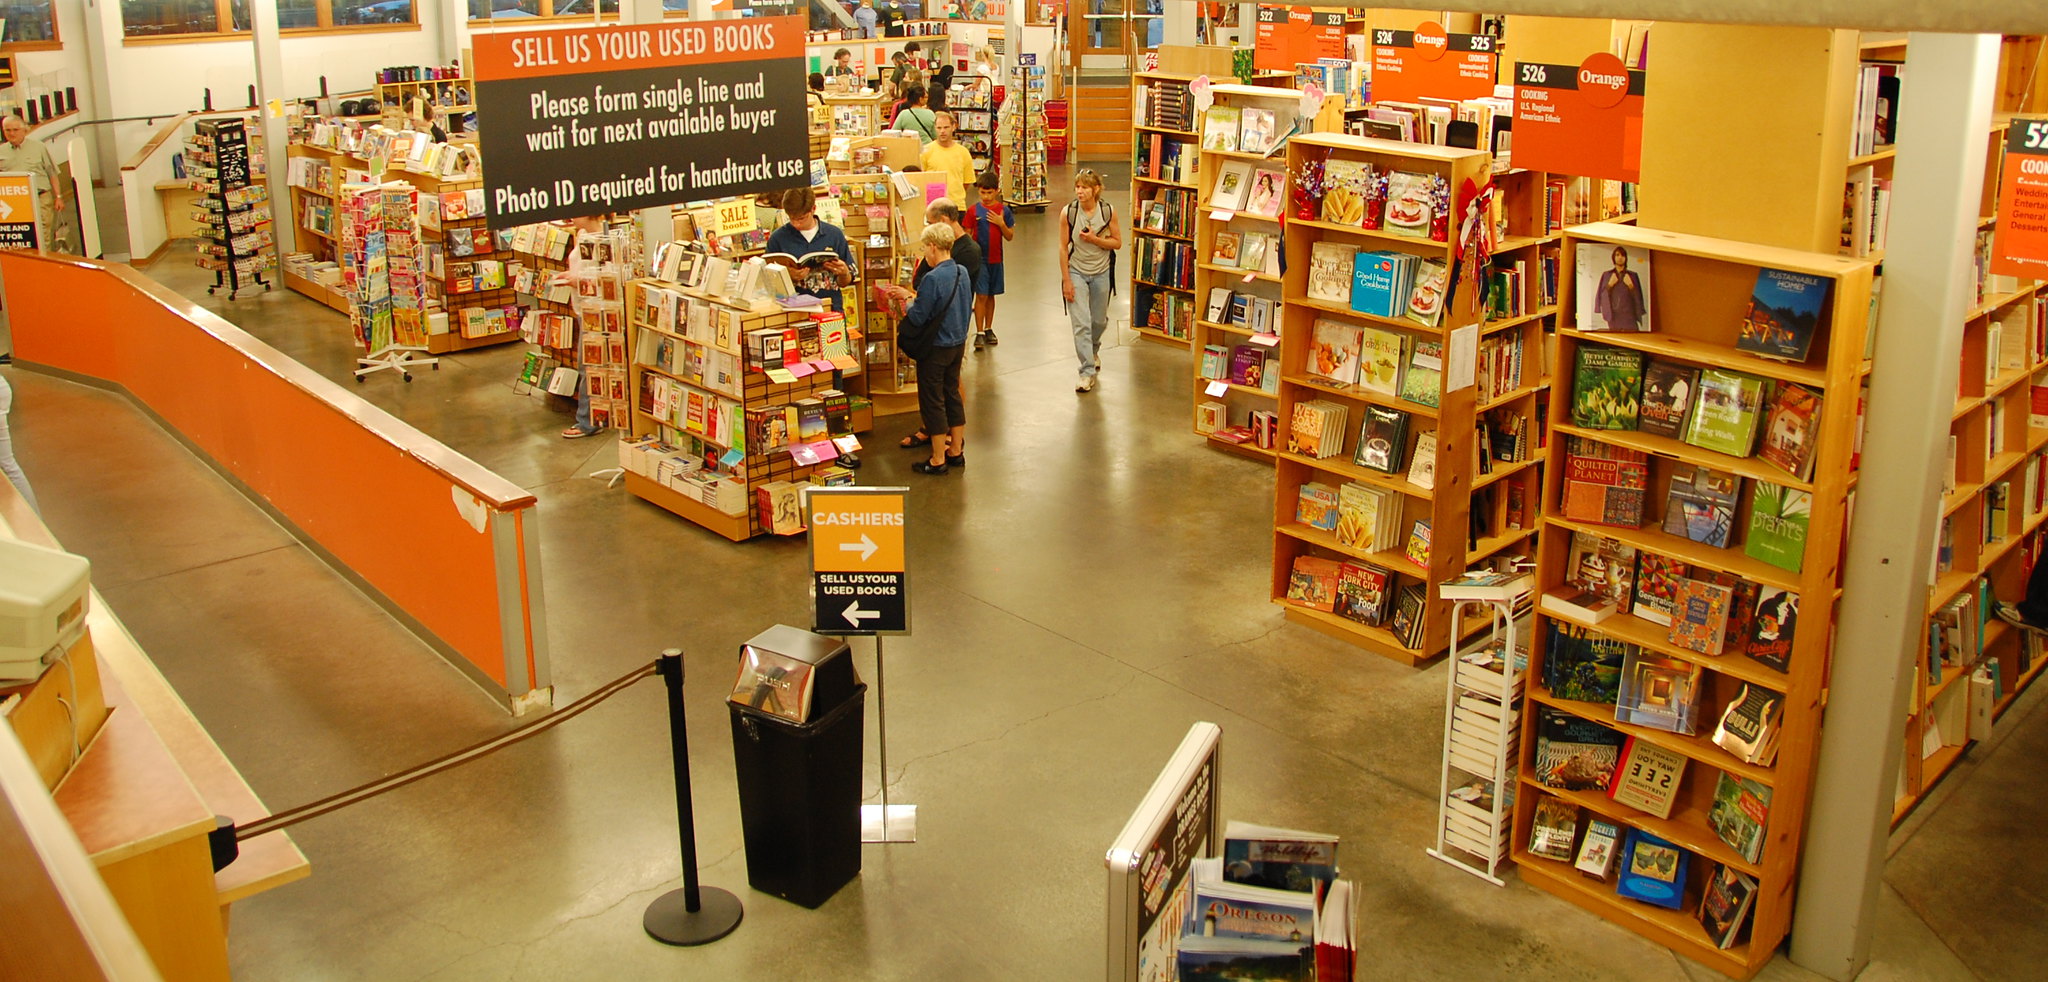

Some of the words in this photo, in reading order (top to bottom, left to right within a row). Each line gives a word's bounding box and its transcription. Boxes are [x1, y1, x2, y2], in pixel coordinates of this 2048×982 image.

[1260, 11, 1273, 21] 522
[1289, 11, 1312, 22] Orange
[1328, 14, 1341, 25] 523
[1376, 31, 1393, 44] 524
[1414, 33, 1446, 48] Orange
[1470, 36, 1490, 50] 525
[511, 36, 558, 68] SELL
[565, 34, 591, 64] US
[597, 29, 651, 61] YOUR
[658, 27, 707, 57] USED
[713, 23, 775, 53] BOOKS
[1521, 64, 1547, 83] 526
[1580, 69, 1626, 90] Orange
[530, 91, 589, 120] Please
[595, 84, 637, 114] form
[642, 79, 693, 113] single
[698, 77, 729, 103] line
[734, 72, 765, 100] and
[1520, 89, 1549, 101] COOKING
[1520, 111, 1544, 122] American
[525, 125, 565, 153] wait
[571, 119, 598, 147] for
[604, 117, 643, 143] next
[648, 109, 725, 140] available
[730, 105, 777, 136] buyer
[0, 185, 29, 196] IERS
[495, 185, 549, 216] Photo
[554, 180, 576, 207] ID
[580, 167, 655, 207] required
[660, 165, 685, 194] for
[690, 153, 773, 191] handtruck
[777, 157, 804, 178] use
[721, 205, 749, 223] SALE
[2012, 210, 2046, 222] General
[12, 224, 30, 232] AND
[722, 220, 750, 231] books
[1356, 270, 1373, 280] Good
[1373, 273, 1391, 284] Home
[1768, 271, 1819, 286] SUSTAINABLE
[1360, 279, 1390, 291] Cookbook
[1776, 280, 1806, 291] HOMES
[1585, 359, 1607, 367] DAMP
[1607, 360, 1640, 369] GARDEN
[1640, 405, 1669, 420] Oven
[1291, 413, 1323, 433] COAST
[1290, 423, 1321, 439] COOKING
[1573, 459, 1617, 472] QUILTED
[1574, 470, 1615, 482] PLANET
[1314, 490, 1330, 502] USA
[812, 512, 904, 526] CASHIERS
[1752, 515, 1804, 542] plants
[820, 574, 847, 584] SELL
[849, 574, 864, 584] US
[865, 574, 897, 584] YOUR
[1343, 572, 1362, 587] YORK
[1362, 579, 1380, 591] CITY
[1357, 569, 1375, 580] NEW
[824, 586, 854, 595] USED
[856, 586, 897, 596] BOOKS
[1358, 596, 1377, 612] Food
[1650, 600, 1672, 615] Blend
[756, 673, 791, 692] PUSH
[1209, 901, 1298, 925] OREGON
